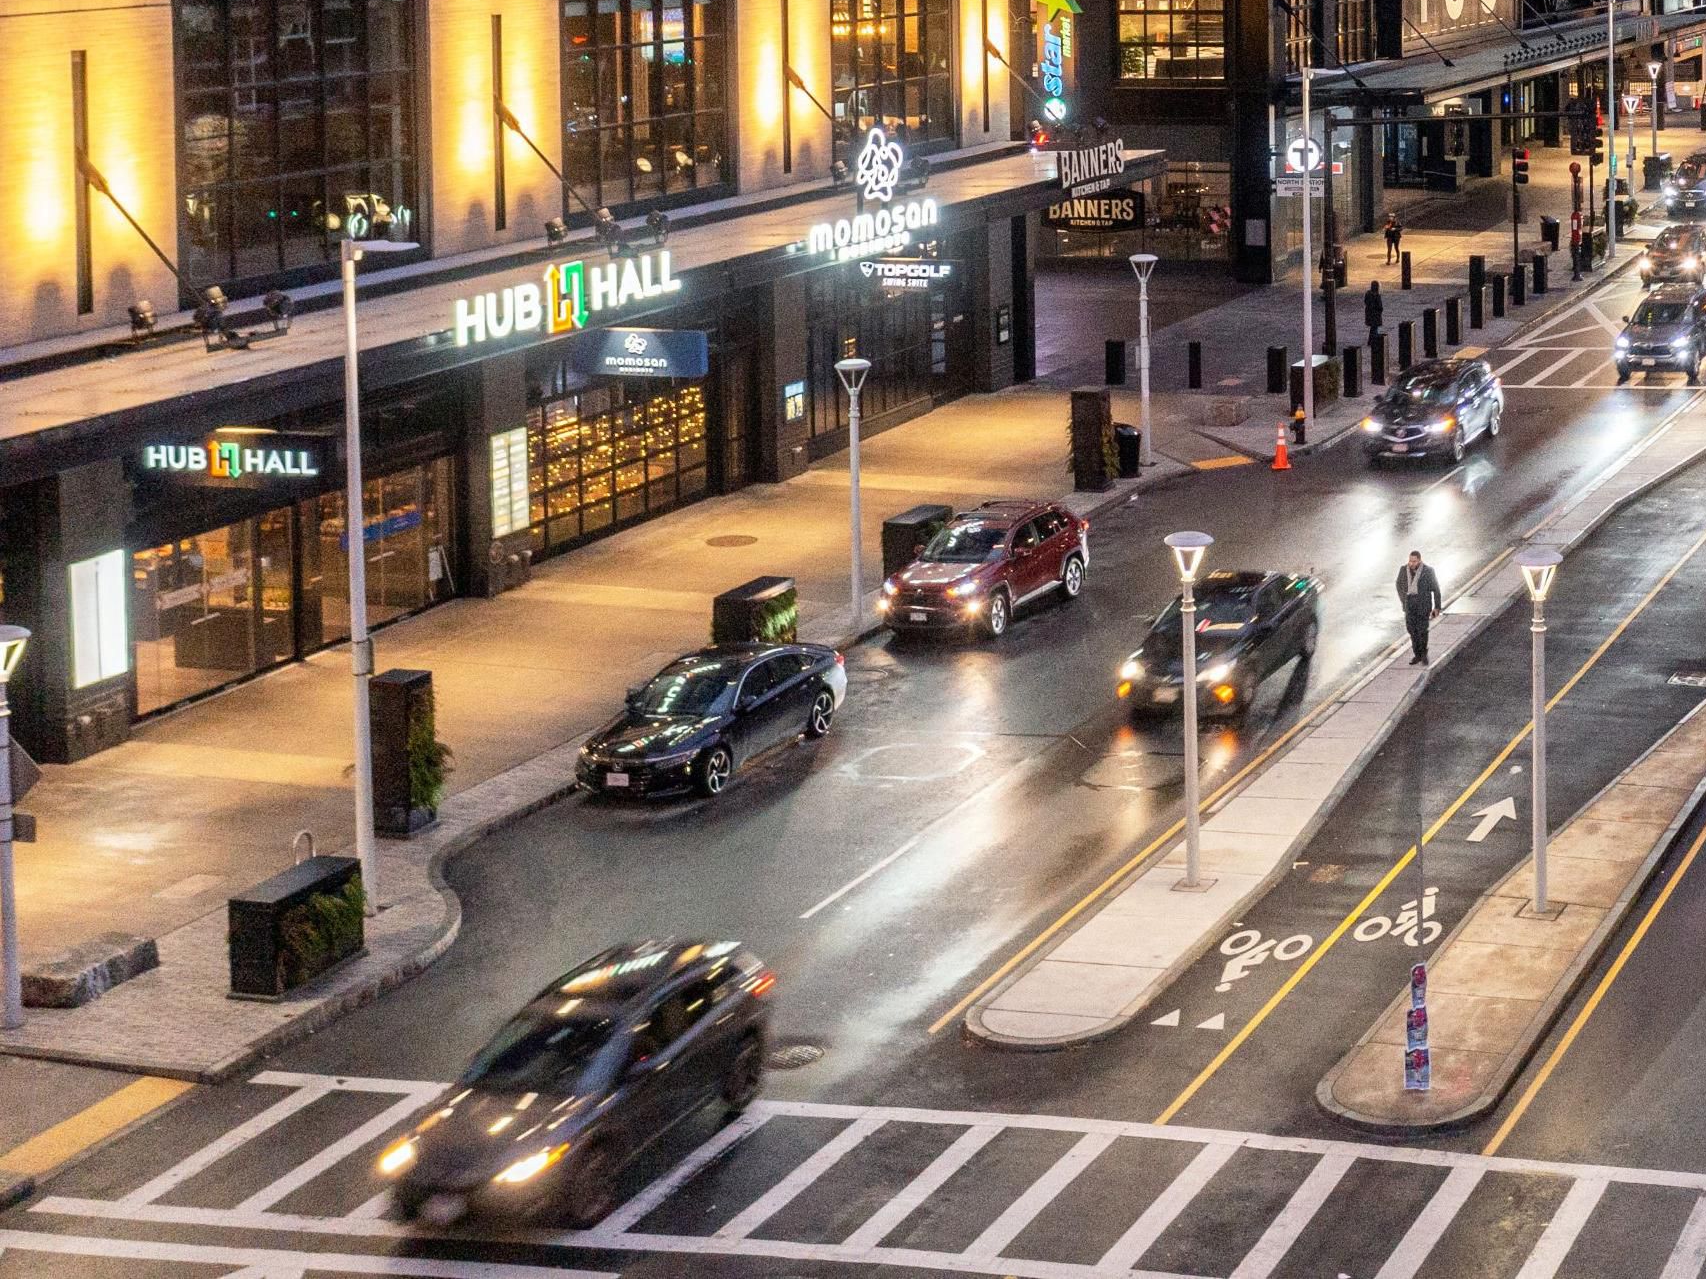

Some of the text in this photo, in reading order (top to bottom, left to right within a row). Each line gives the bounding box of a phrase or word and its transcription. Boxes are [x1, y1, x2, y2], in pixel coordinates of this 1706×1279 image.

[1060, 17, 1072, 58] market
[1041, 24, 1063, 97] star
[1061, 138, 1124, 189] BANNERS
[809, 198, 938, 254] momosan
[1049, 198, 1134, 220] BANNERS
[874, 263, 951, 278] TOPGOLF
[454, 250, 682, 347] HUB HALL
[605, 356, 668, 368] momosan
[147, 445, 321, 475] HUB HALL
